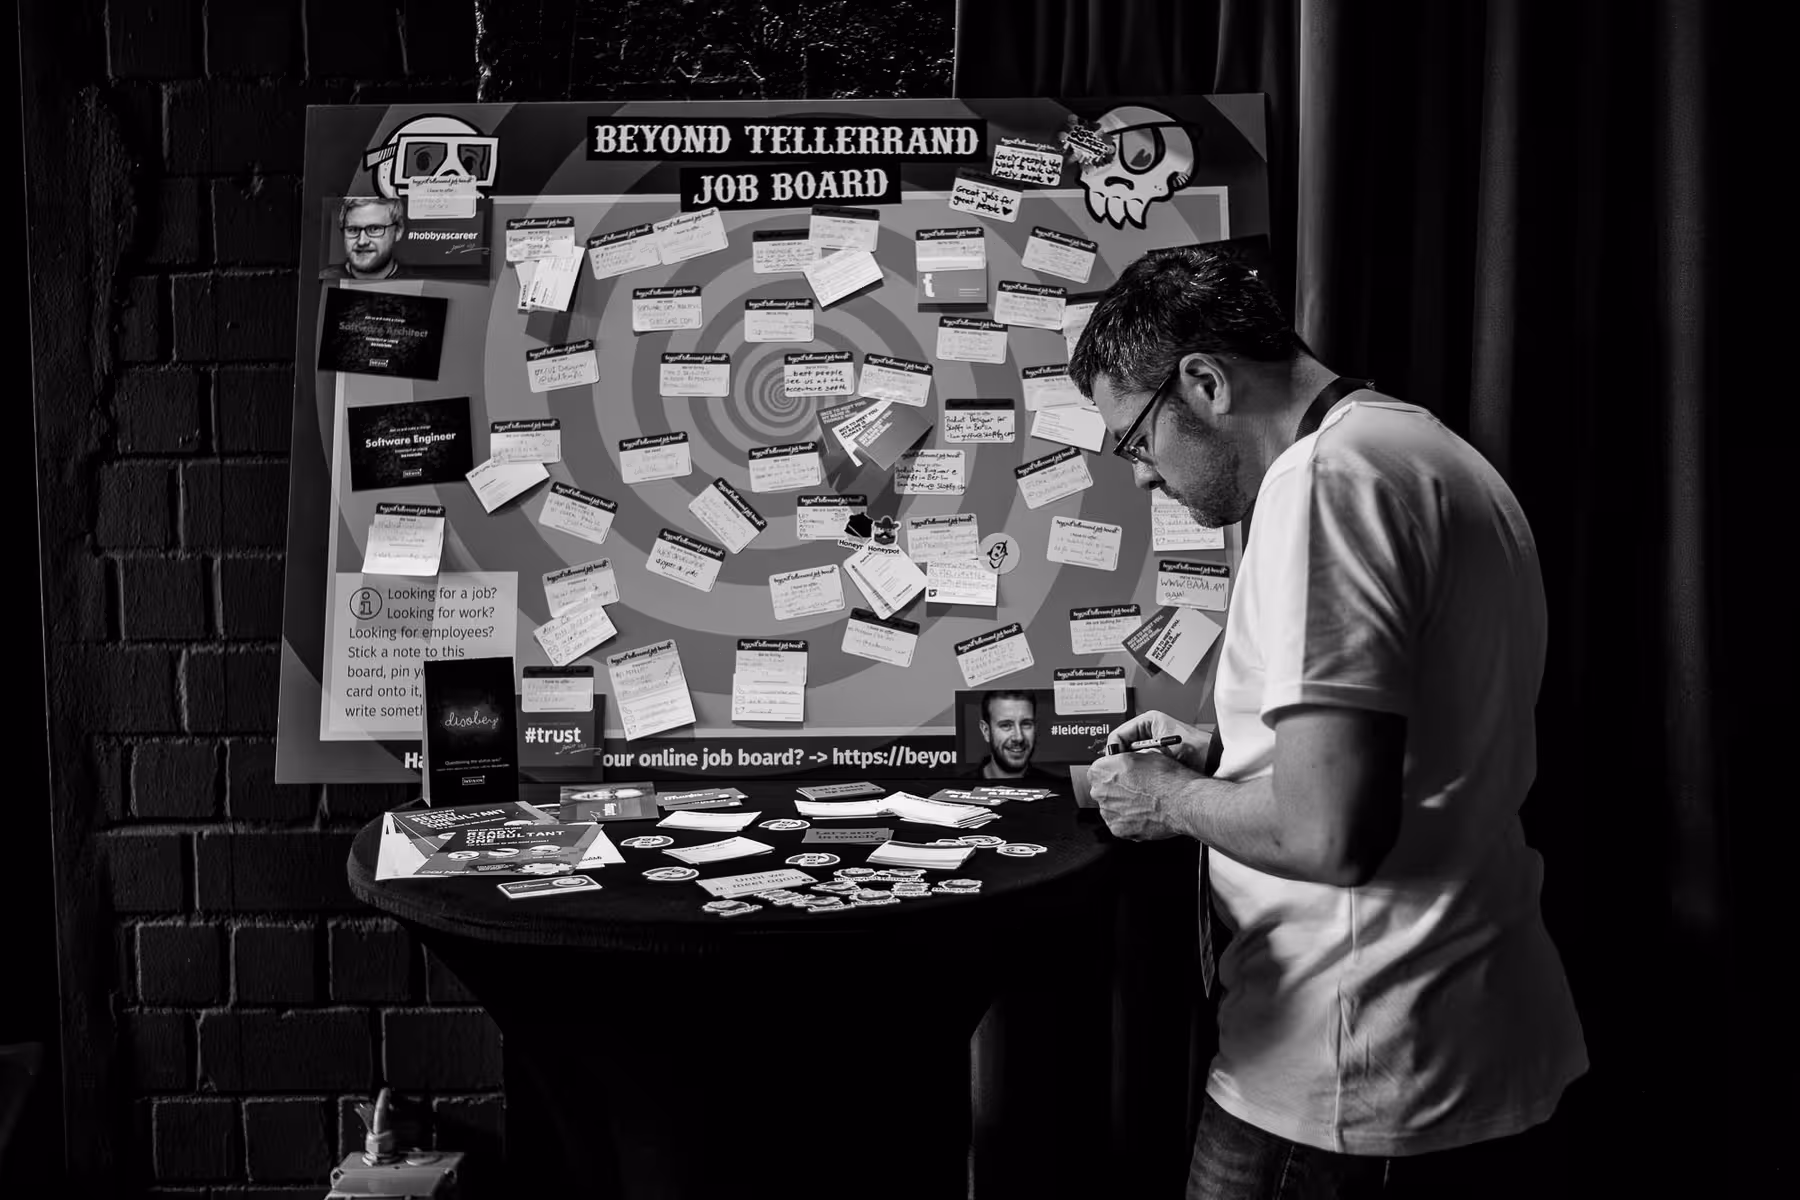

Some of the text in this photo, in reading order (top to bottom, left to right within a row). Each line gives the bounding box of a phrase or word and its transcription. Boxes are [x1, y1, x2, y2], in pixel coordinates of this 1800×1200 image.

[594, 124, 980, 155] BEYOND TELLERRAND
[693, 168, 889, 204] JOB BOARD
[956, 185, 980, 198] Great
[1000, 195, 1014, 205] for
[952, 195, 1000, 214] great people
[408, 231, 478, 242] #hobbyascareer
[386, 325, 428, 338] Architect
[365, 432, 456, 448] Software Engineer
[868, 546, 900, 554] Honeypot
[388, 587, 498, 602] Looking for a job?
[387, 606, 495, 622] Looking for work?
[349, 626, 495, 641] Looking for employees?
[348, 645, 465, 658] Stick a note to this
[347, 666, 386, 679] board,
[390, 666, 410, 680] pin
[346, 685, 422, 698] card onto it,
[345, 705, 376, 718] write
[444, 710, 500, 730] disobey
[525, 727, 582, 744] #trust
[1050, 724, 1110, 736] #leidergeil
[639, 748, 698, 767] online
[701, 748, 733, 770] job
[738, 748, 804, 766] board?
[732, 876, 802, 888] meet again
